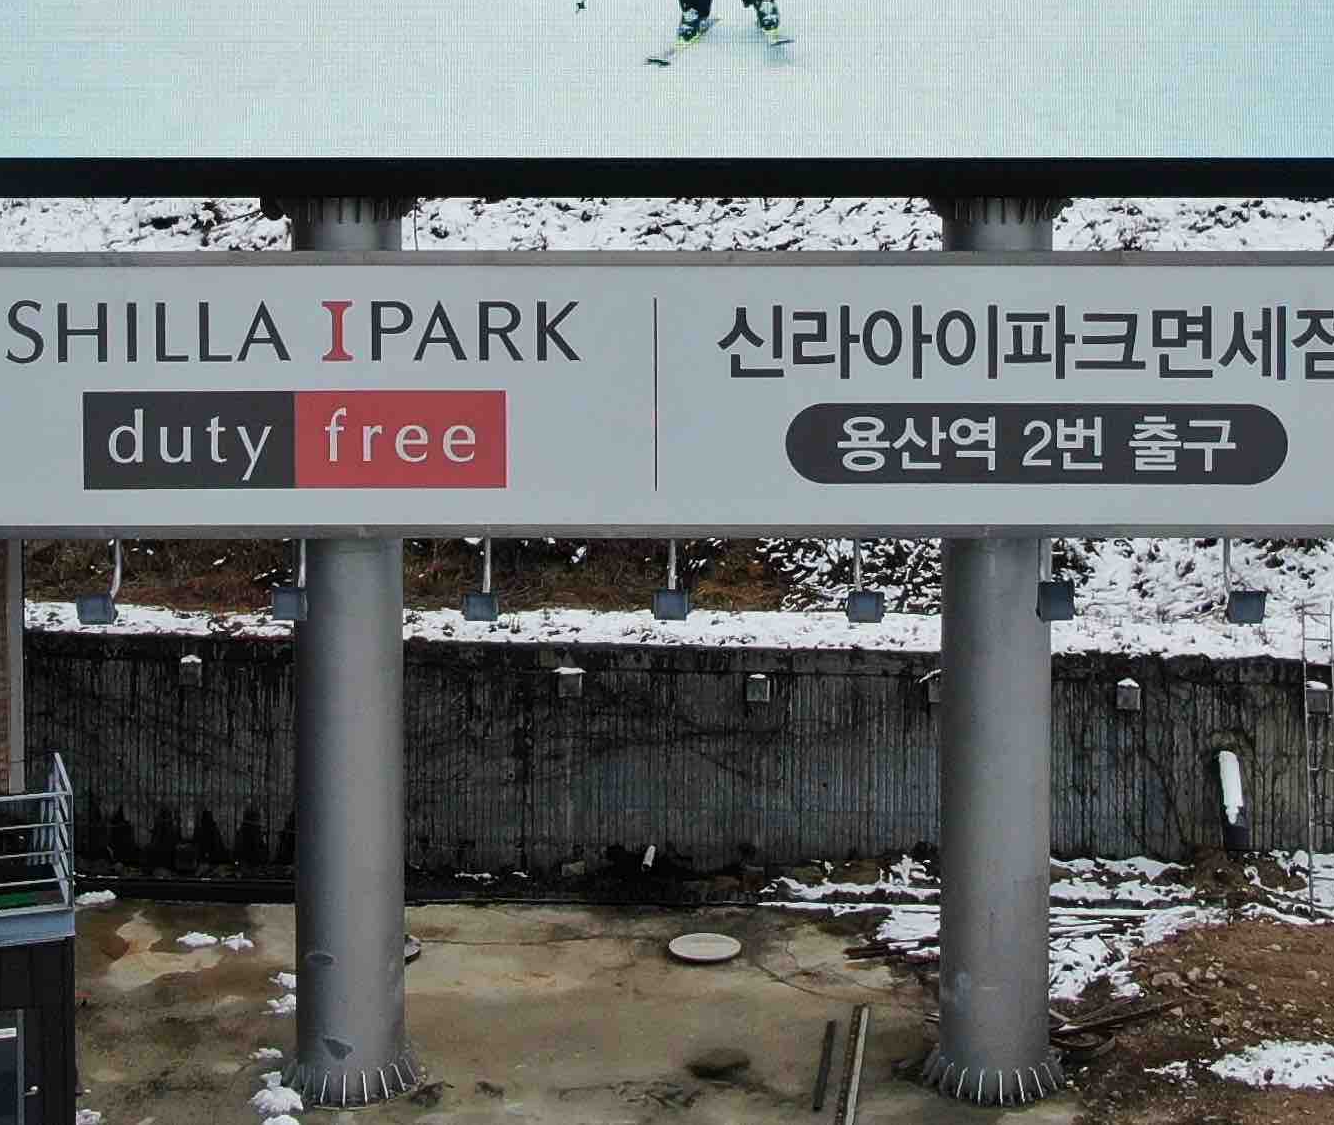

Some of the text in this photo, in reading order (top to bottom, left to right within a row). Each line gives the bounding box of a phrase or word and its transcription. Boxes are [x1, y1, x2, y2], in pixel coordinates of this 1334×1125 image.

[5, 299, 582, 364] SHILLA IPARK
[107, 407, 477, 481] duty free
[836, 415, 1237, 472] 용산역 2번 출구
